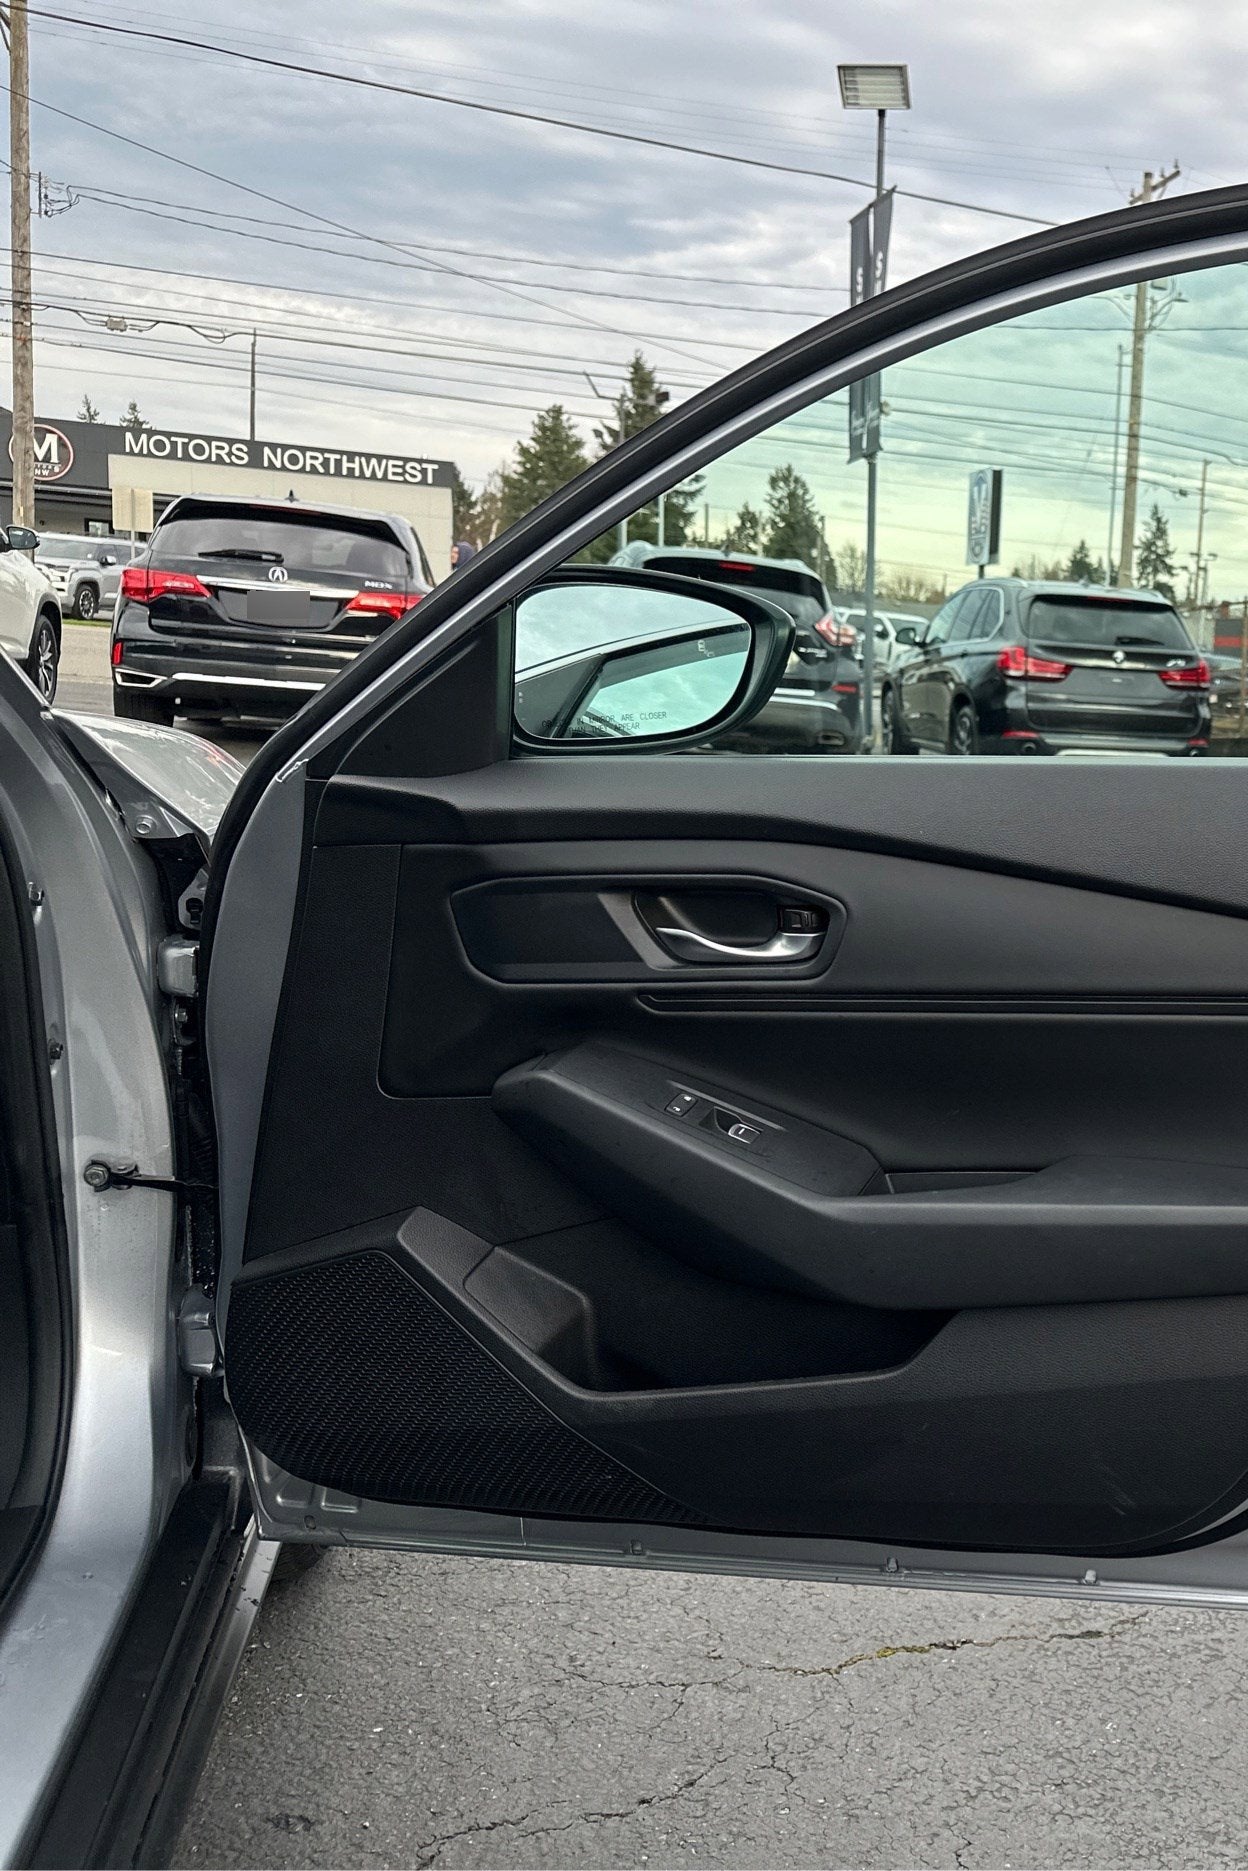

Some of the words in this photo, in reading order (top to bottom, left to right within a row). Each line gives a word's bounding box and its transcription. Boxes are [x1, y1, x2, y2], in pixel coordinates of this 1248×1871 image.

[124, 431, 249, 465] MOTORS
[263, 445, 440, 485] NORTHWEST
[621, 713, 634, 722] ARE
[640, 711, 667, 720] CLOSER
